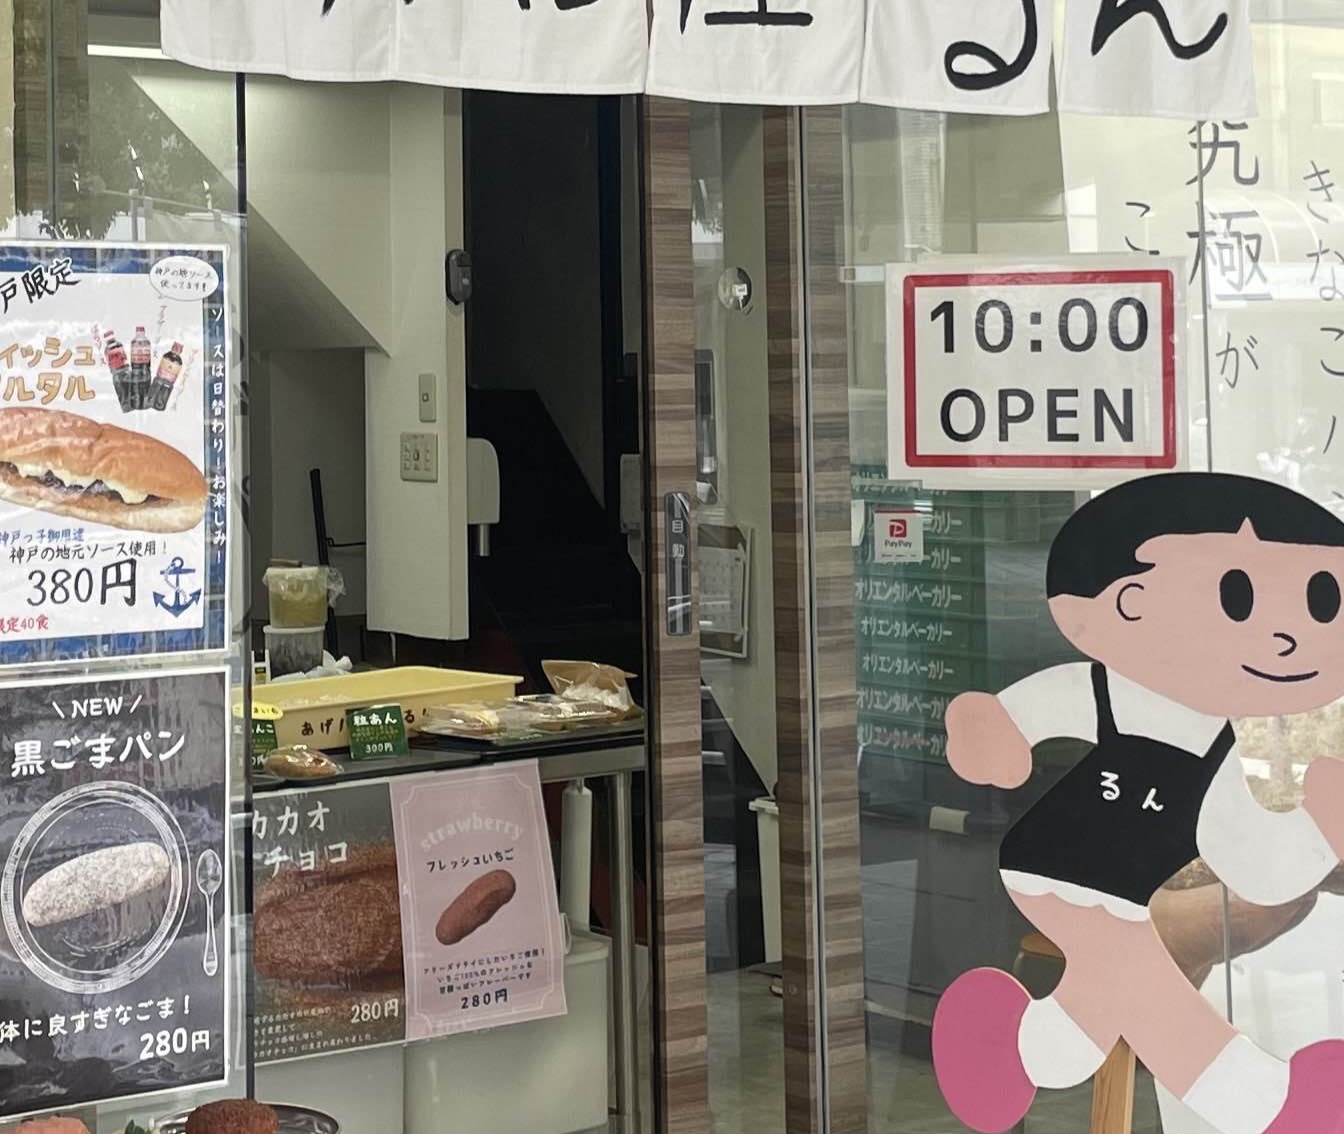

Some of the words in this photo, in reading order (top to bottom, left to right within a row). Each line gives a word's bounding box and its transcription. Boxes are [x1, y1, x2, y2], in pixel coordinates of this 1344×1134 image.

[929, 297, 1149, 354] 10:00
[939, 387, 1135, 443] OPEN
[884, 539, 912, 549] PayPay
[26, 557, 137, 608] 380円
[860, 617, 953, 642] オリエンタルベーカリー
[862, 655, 954, 680] オリエンタルベーカリー
[71, 695, 124, 719] NEW
[10, 730, 185, 778] 黒ごまパン
[365, 742, 394, 753] 300円
[1100, 770, 1164, 812] るん
[252, 800, 330, 839] カカオ
[420, 811, 525, 853] strawberry
[263, 841, 349, 879] チョコ
[426, 847, 514, 873] フレッシュいちご
[351, 998, 399, 1024] 280円
[461, 988, 508, 1010] 280円
[139, 1028, 210, 1061] 280円
